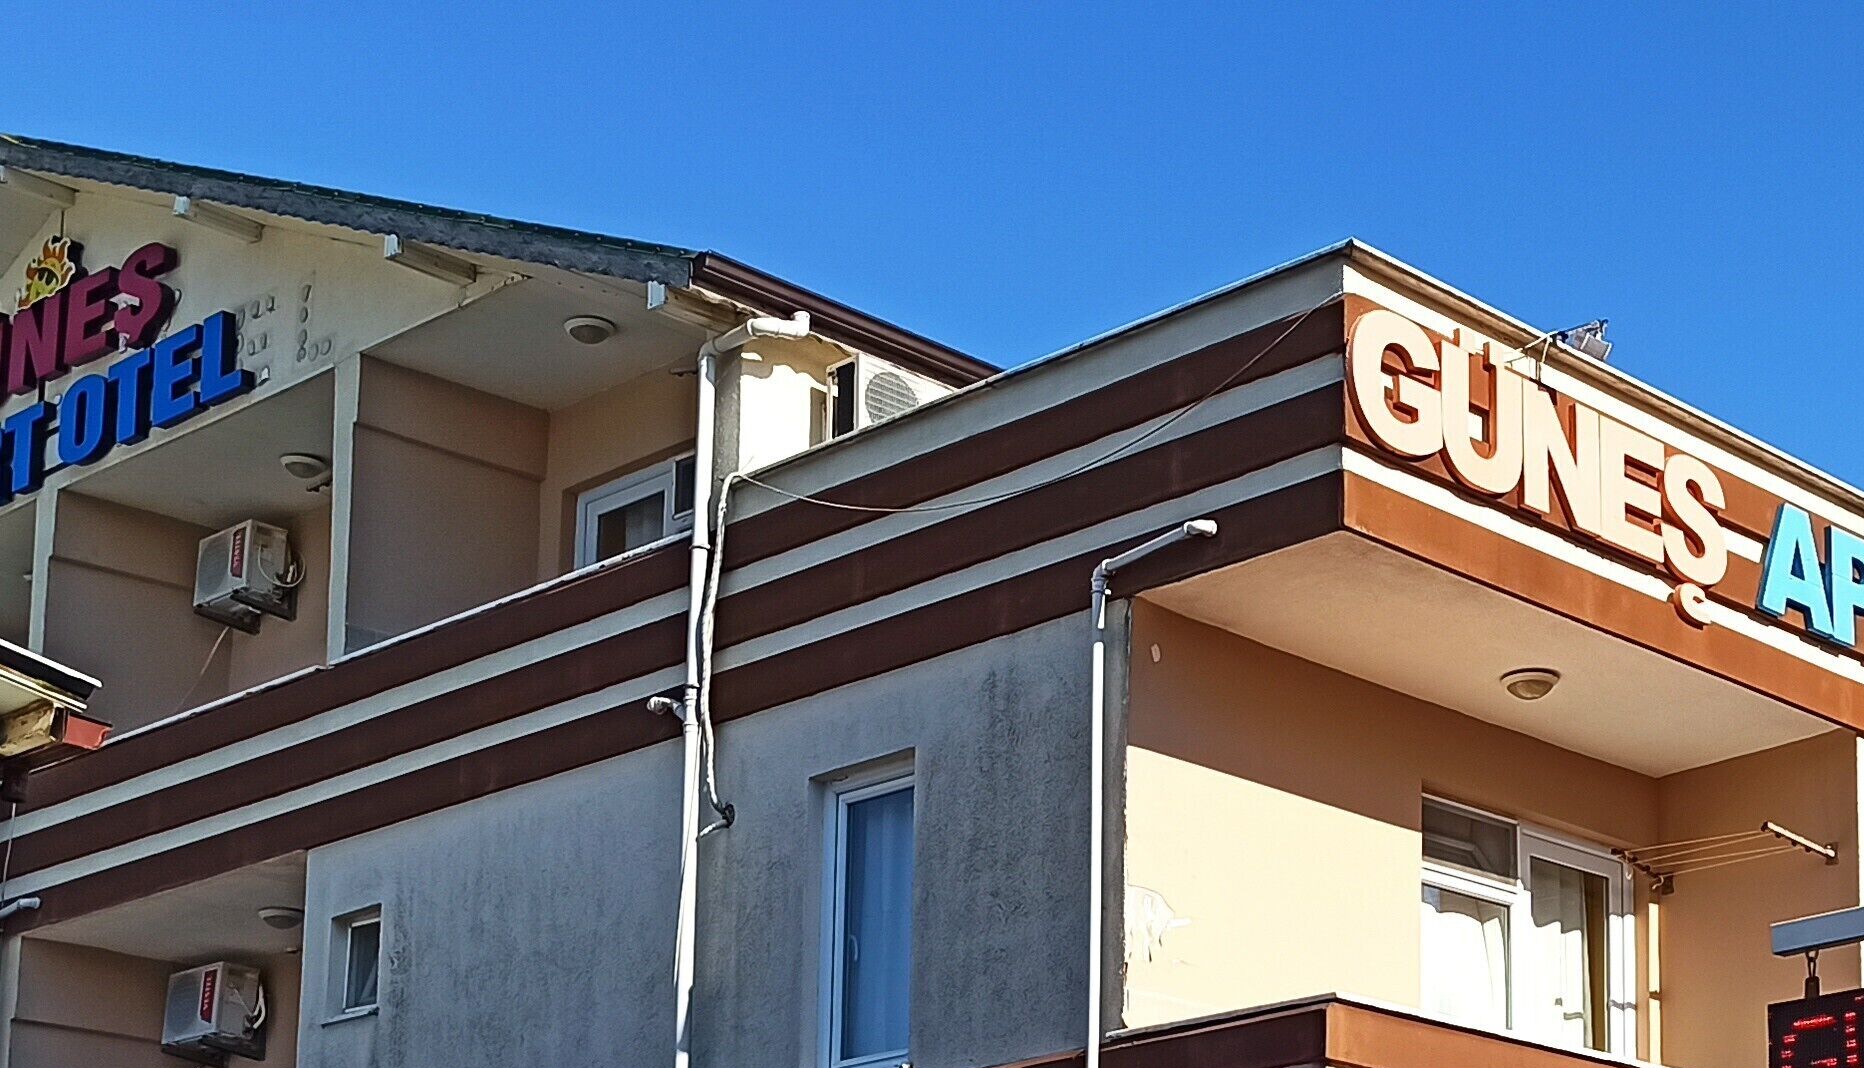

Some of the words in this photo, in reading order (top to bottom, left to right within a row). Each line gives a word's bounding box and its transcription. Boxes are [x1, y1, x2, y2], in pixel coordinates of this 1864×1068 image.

[0, 242, 175, 396] NEŞ
[58, 310, 249, 464] OTEL
[1346, 309, 1728, 630] GÜNEŞ
